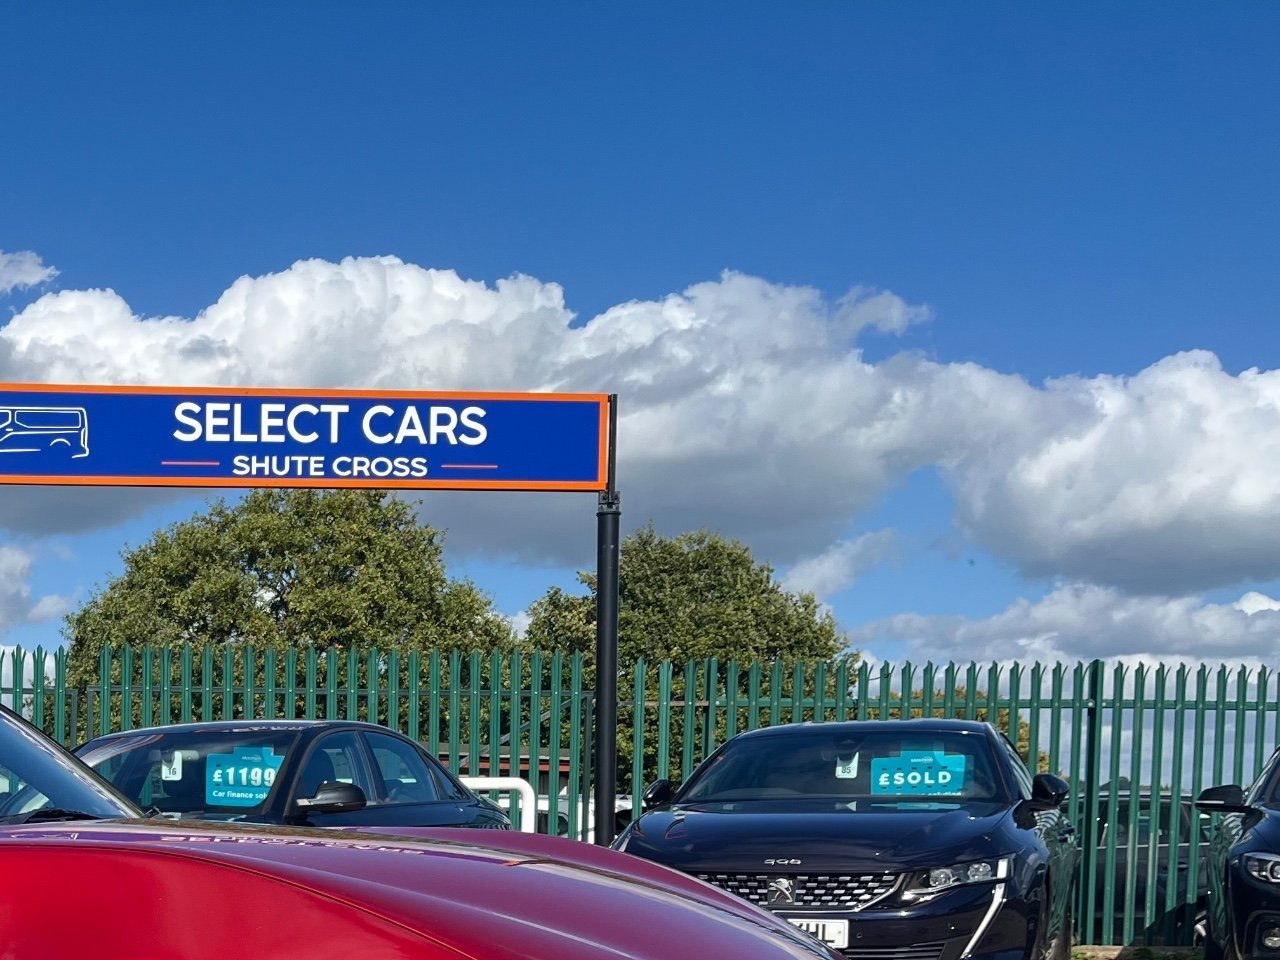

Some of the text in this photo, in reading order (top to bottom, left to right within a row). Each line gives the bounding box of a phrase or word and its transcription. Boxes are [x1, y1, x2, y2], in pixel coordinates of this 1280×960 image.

[172, 402, 488, 446] SELECT CARS
[232, 455, 428, 478] SHUTE CROSS
[167, 767, 177, 776] 16
[227, 791, 253, 799] finance
